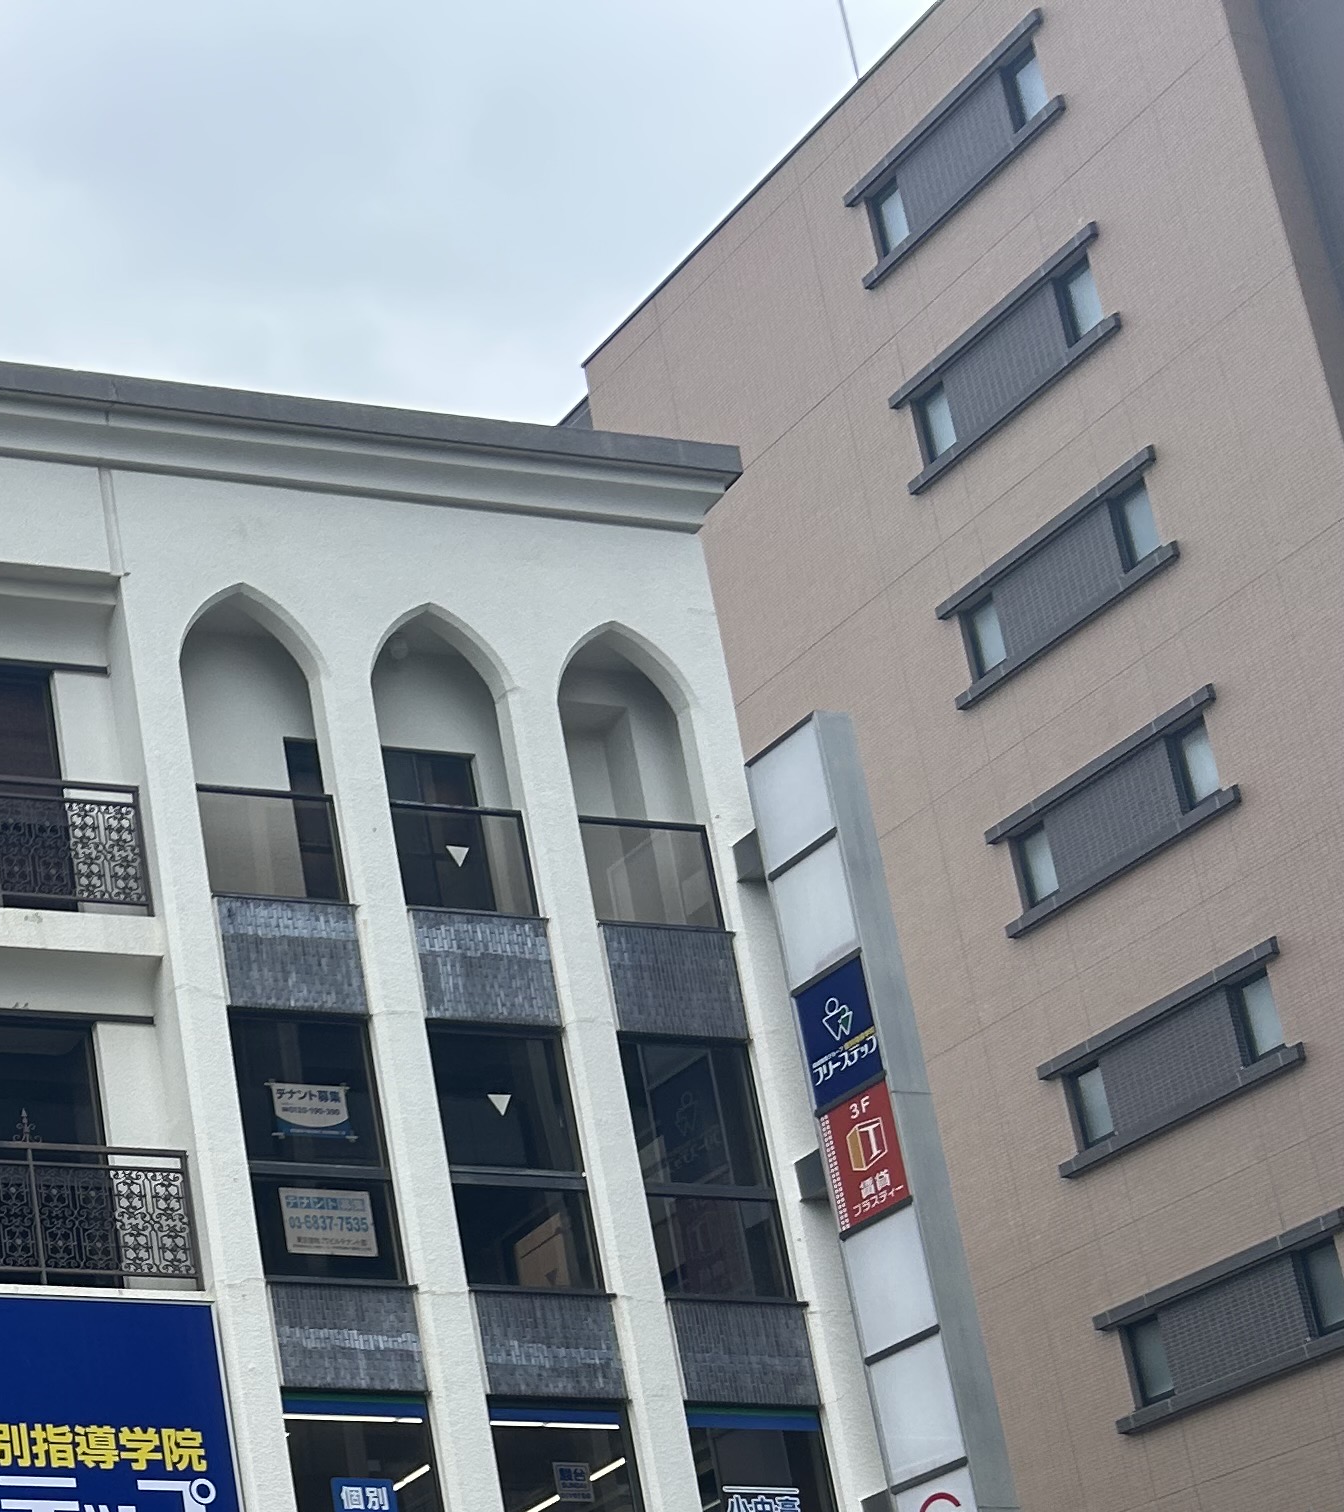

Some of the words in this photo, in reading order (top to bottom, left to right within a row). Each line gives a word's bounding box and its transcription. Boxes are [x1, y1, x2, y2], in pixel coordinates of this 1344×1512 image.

[813, 1035, 878, 1086] フリーステップ
[276, 1088, 342, 1103] テナント募集
[849, 1096, 871, 1120] 3F
[853, 1185, 904, 1217] プラスティー
[289, 1215, 370, 1233] 03-6837-7535
[340, 1485, 391, 1512] 個別
